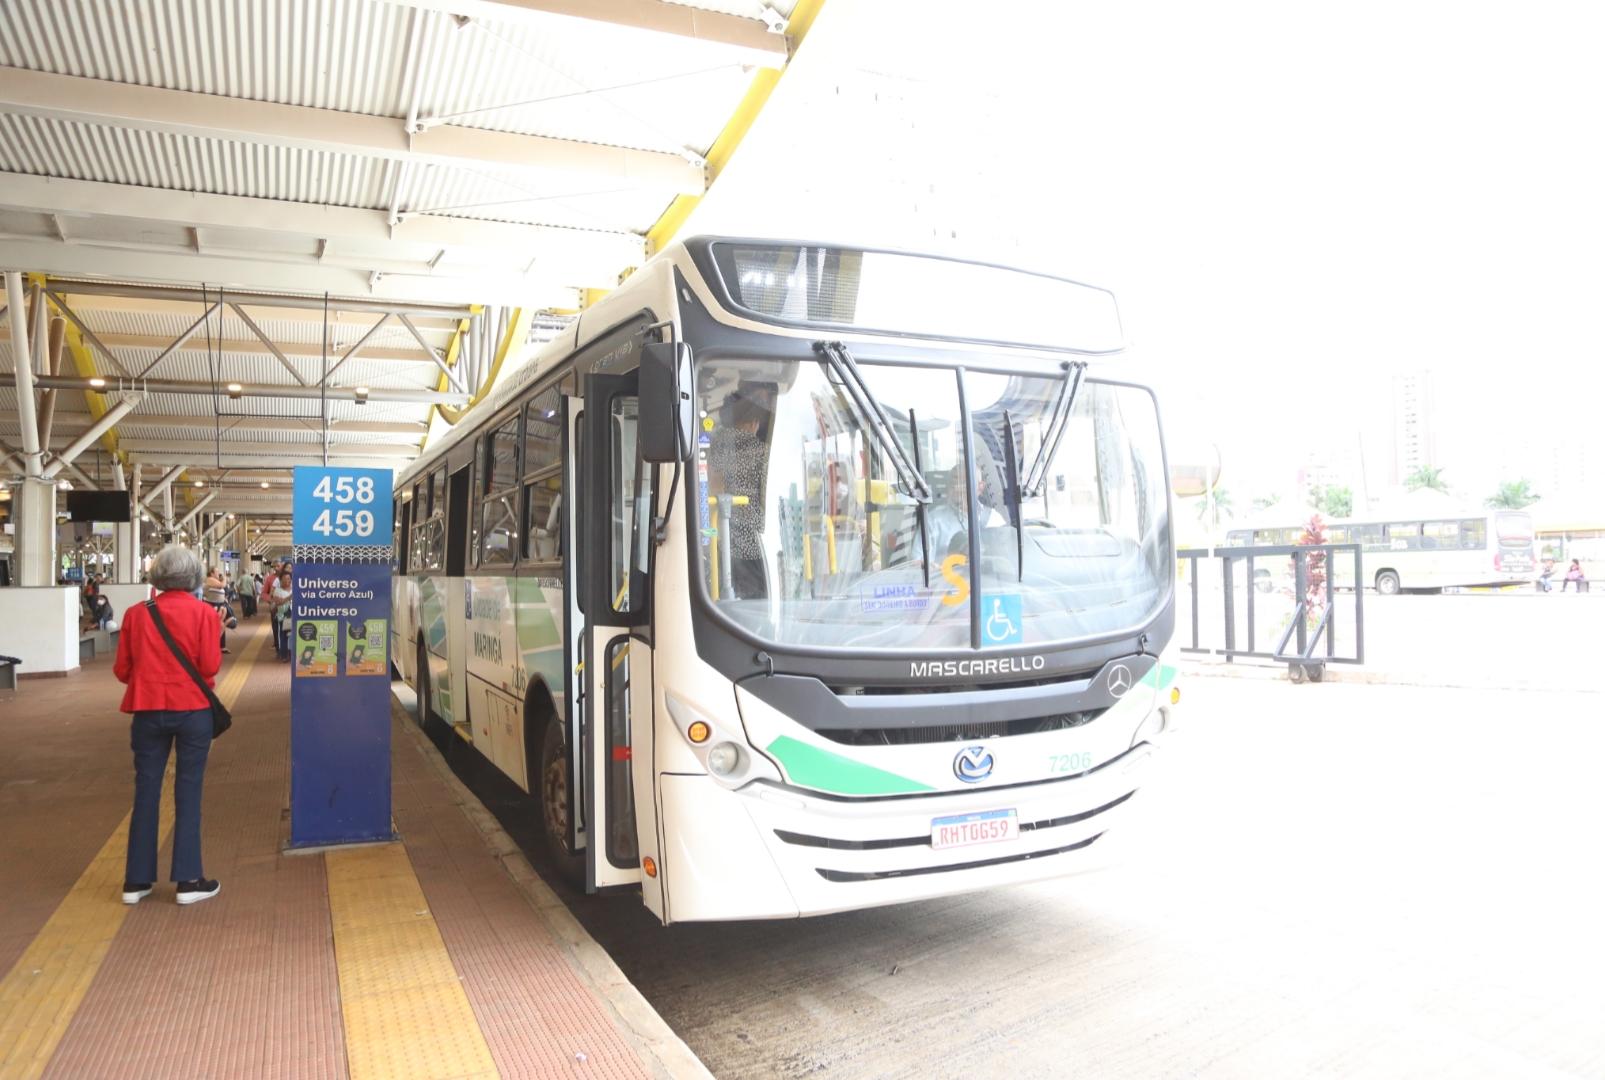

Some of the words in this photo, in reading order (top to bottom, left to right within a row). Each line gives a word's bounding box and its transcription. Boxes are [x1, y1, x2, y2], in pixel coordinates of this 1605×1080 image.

[312, 475, 375, 504] 458
[312, 508, 375, 537] 459
[298, 577, 358, 589] Universo
[942, 554, 970, 606] S
[301, 590, 316, 599] via
[318, 590, 347, 599] Cerro
[348, 589, 374, 600] Azul)
[874, 586, 915, 598] LINHA
[297, 605, 358, 617] Universo
[474, 631, 503, 666] MARINGÁ
[910, 655, 1045, 678] MASCARELLO
[1048, 752, 1092, 773] 7206
